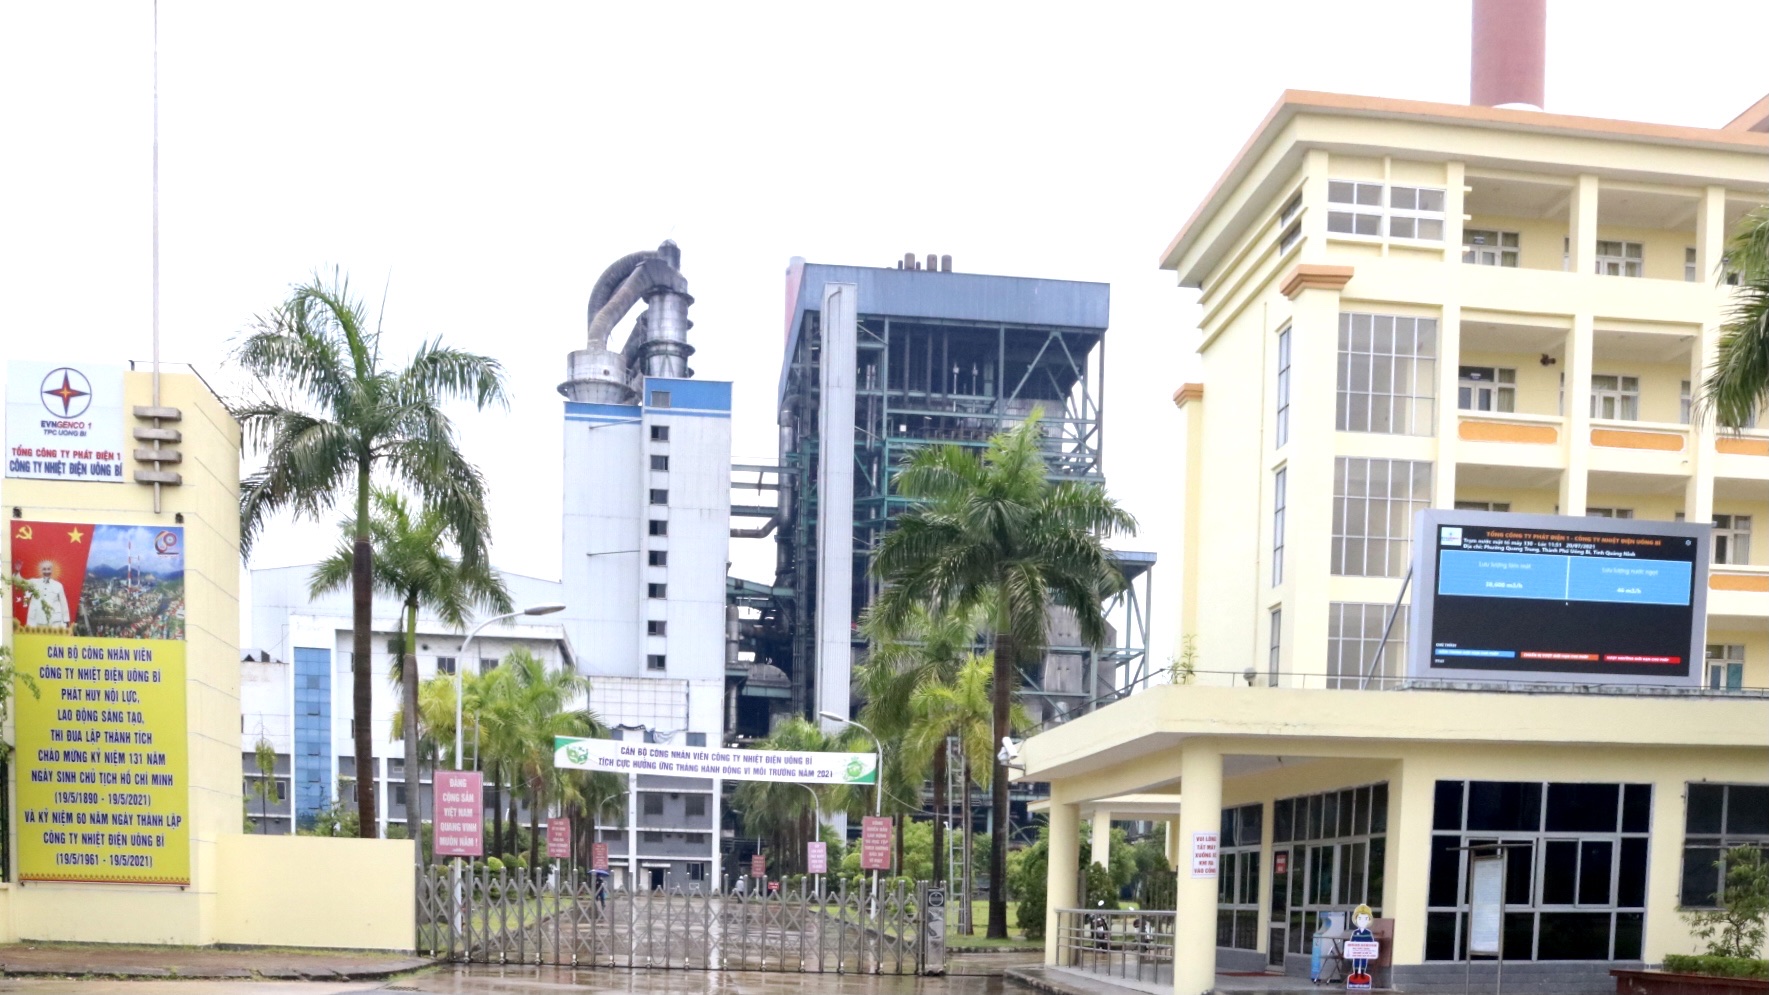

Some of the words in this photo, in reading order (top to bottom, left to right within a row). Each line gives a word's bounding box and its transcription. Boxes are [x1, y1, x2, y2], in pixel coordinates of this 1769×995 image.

[41, 420, 85, 429] EVNGENCO
[88, 422, 92, 430] 1
[12, 444, 32, 457] TỔNG
[36, 446, 57, 458] CÔNG
[61, 450, 72, 459] TY
[73, 447, 92, 460] PHÁT
[96, 448, 114, 462] ĐIỆN
[9, 459, 31, 473] CÔNG
[33, 462, 43, 474] TY
[44, 460, 67, 476] NHIỆT
[69, 460, 87, 477] ĐIỆN
[90, 461, 111, 476] UÔNG
[114, 461, 123, 477] BÍ
[47, 644, 64, 659] CÁN
[67, 644, 78, 661] BỘ
[82, 645, 104, 660] CÔNG
[107, 646, 130, 661] NHÂN
[134, 647, 152, 662] VIÊN
[39, 664, 62, 679] CÔNG
[65, 667, 74, 679] TY
[77, 666, 101, 684] NHIỆT
[104, 667, 124, 684] ĐIỆN
[127, 668, 149, 683] UÔNG
[152, 670, 161, 683] BÍ
[61, 686, 82, 701] PHÁT
[85, 689, 101, 701] HUY
[104, 687, 119, 705] NỘI
[57, 709, 72, 721] LAO
[76, 707, 98, 725] ĐỘNG
[101, 707, 124, 723] SÁNG
[50, 729, 63, 742] THI
[66, 729, 83, 742] ĐUA
[86, 727, 100, 745] LẬP
[104, 728, 131, 744] THÀNH
[134, 730, 152, 745] TÍCH
[38, 747, 60, 762] CHÀO
[63, 747, 88, 763] MỪNG
[91, 748, 101, 763] KỶ
[104, 749, 126, 767] NIỆM
[129, 753, 143, 765] 131
[147, 750, 166, 766] NĂM
[637, 747, 648, 758] BỘ
[650, 747, 669, 758] CÔNG
[671, 749, 691, 760] NHÂN
[693, 750, 709, 761] VIÊN
[711, 752, 730, 762] CÔNG
[732, 755, 741, 763] TY
[743, 754, 763, 764] NHIỆT
[765, 755, 782, 765] ĐIỆN
[784, 755, 803, 765] UÔNG
[805, 756, 813, 765] BÍ
[598, 757, 614, 767] TÍCH
[616, 758, 630, 769] CỰC
[632, 757, 657, 770] HƯỞNG
[659, 759, 674, 771] ỨNG
[676, 761, 699, 772] THÁNG
[701, 763, 720, 774] HÀNH
[722, 765, 742, 776] ĐỘNG
[753, 767, 766, 776] MÔI
[769, 767, 796, 777] TRƯỜNG
[799, 768, 815, 777] NĂM
[817, 770, 833, 778] 2021
[31, 768, 53, 782] NGÀY
[56, 771, 76, 783] SINH
[79, 769, 96, 784] CHỦ
[99, 772, 117, 787] TỊCH
[120, 769, 131, 785] HỒ
[135, 771, 148, 785] CHÍ
[151, 774, 174, 786] MINH
[54, 791, 98, 805] (19/5/1890
[108, 793, 151, 807] 19/5/2021)
[24, 808, 35, 823] VÀ
[38, 807, 49, 822] KỶ
[52, 809, 74, 828] NIỆM
[76, 812, 87, 825] 60
[89, 811, 109, 825] NĂM
[111, 811, 133, 826] NGÀY
[136, 812, 163, 827] THÀNH
[166, 814, 182, 830] LẬP
[43, 829, 66, 845] CÔNG
[69, 833, 78, 845] TY
[81, 831, 105, 849] NHIỆT
[108, 832, 127, 849] ĐIỆN
[130, 832, 153, 847] UÔNG
[156, 833, 165, 848] BÍ
[56, 852, 99, 865] (19/5/1961
[110, 854, 153, 868] 19/5/2021)
